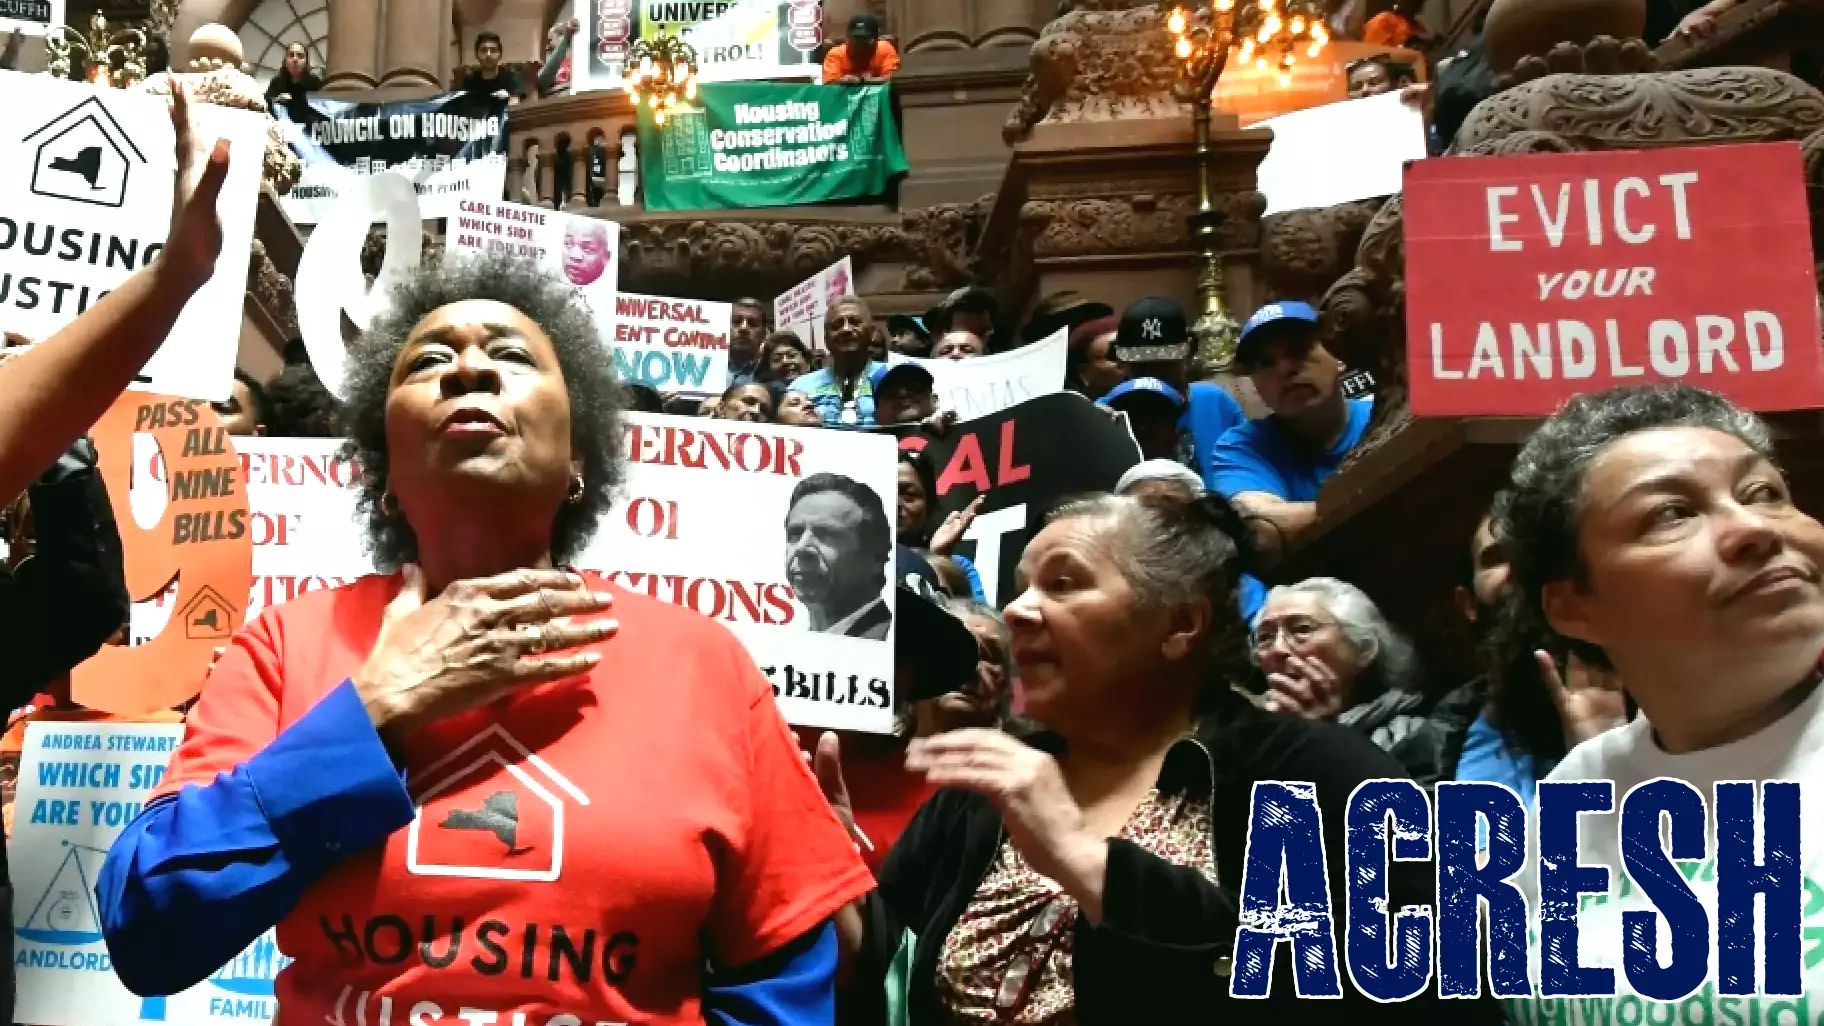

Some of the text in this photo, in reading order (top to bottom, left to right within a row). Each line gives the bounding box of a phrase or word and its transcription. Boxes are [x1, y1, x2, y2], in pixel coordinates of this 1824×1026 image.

[649, 2, 740, 22] UNIVER
[735, 100, 819, 124] Housing
[312, 113, 384, 145] COUNCIL
[390, 114, 415, 139] ON
[421, 113, 498, 141] HOUSING
[711, 119, 847, 150] Conservation
[714, 143, 848, 172] Coordinators
[459, 216, 502, 236] WHICH
[460, 200, 546, 226] CARL HEASTIE
[1486, 172, 1699, 252] EVICT
[0, 272, 112, 317] STI
[1537, 266, 1656, 302] YOUR
[1430, 310, 1785, 381] LANDLORD
[612, 346, 712, 389] NOW
[134, 400, 200, 432] PASS
[181, 427, 227, 458] ALL
[624, 423, 805, 478] ERNOR
[171, 466, 237, 502] NINE
[172, 508, 248, 546] BILLS
[41, 734, 102, 750] ANDREA
[38, 762, 121, 788] WHICH
[30, 798, 81, 826] ARE
[319, 913, 640, 985] HOUSING
